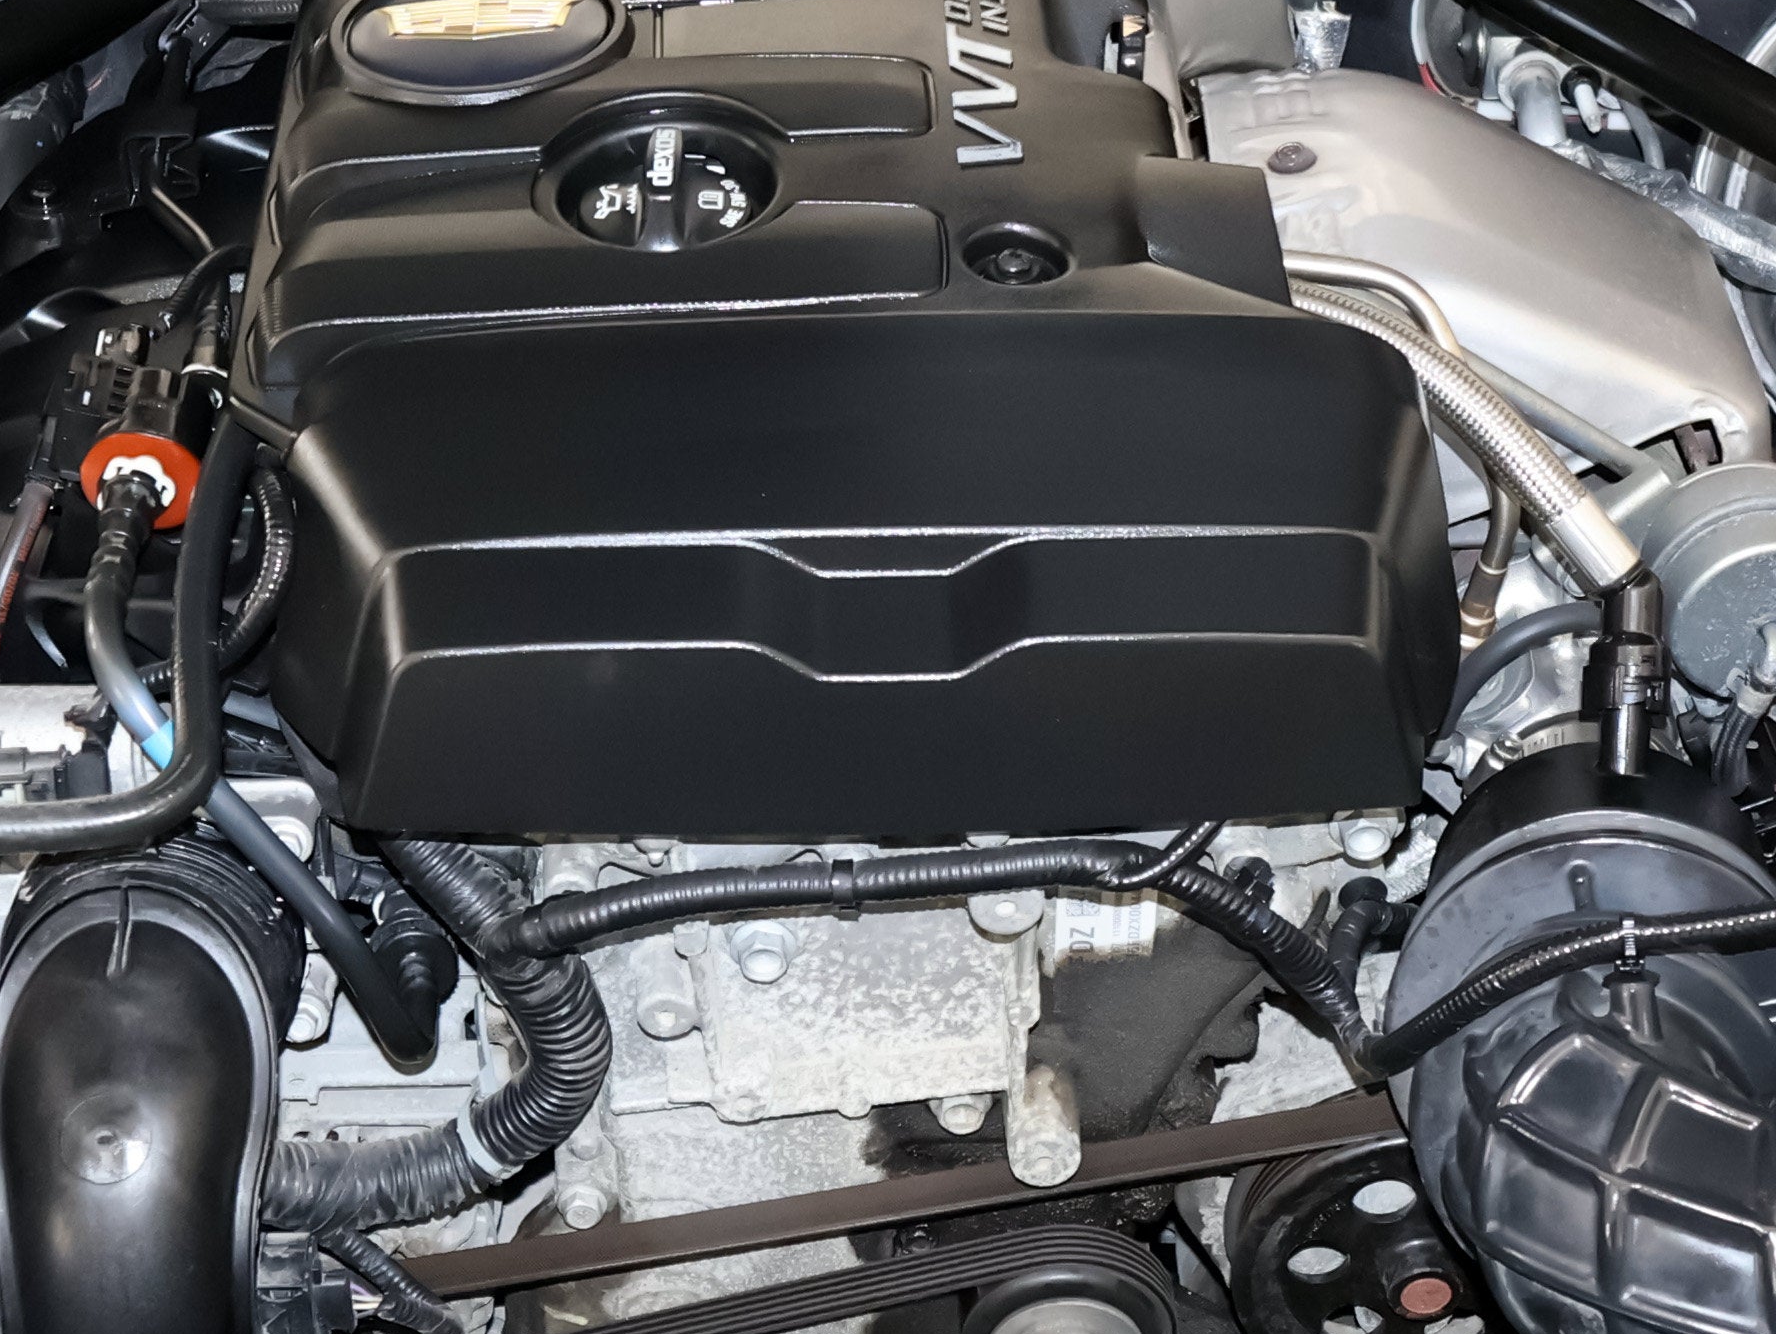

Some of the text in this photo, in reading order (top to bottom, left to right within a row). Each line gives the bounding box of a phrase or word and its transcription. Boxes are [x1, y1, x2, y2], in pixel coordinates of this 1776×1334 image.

[945, 23, 1023, 169] VVT
[645, 128, 676, 187] dexos
[1069, 926, 1095, 953] DZ
